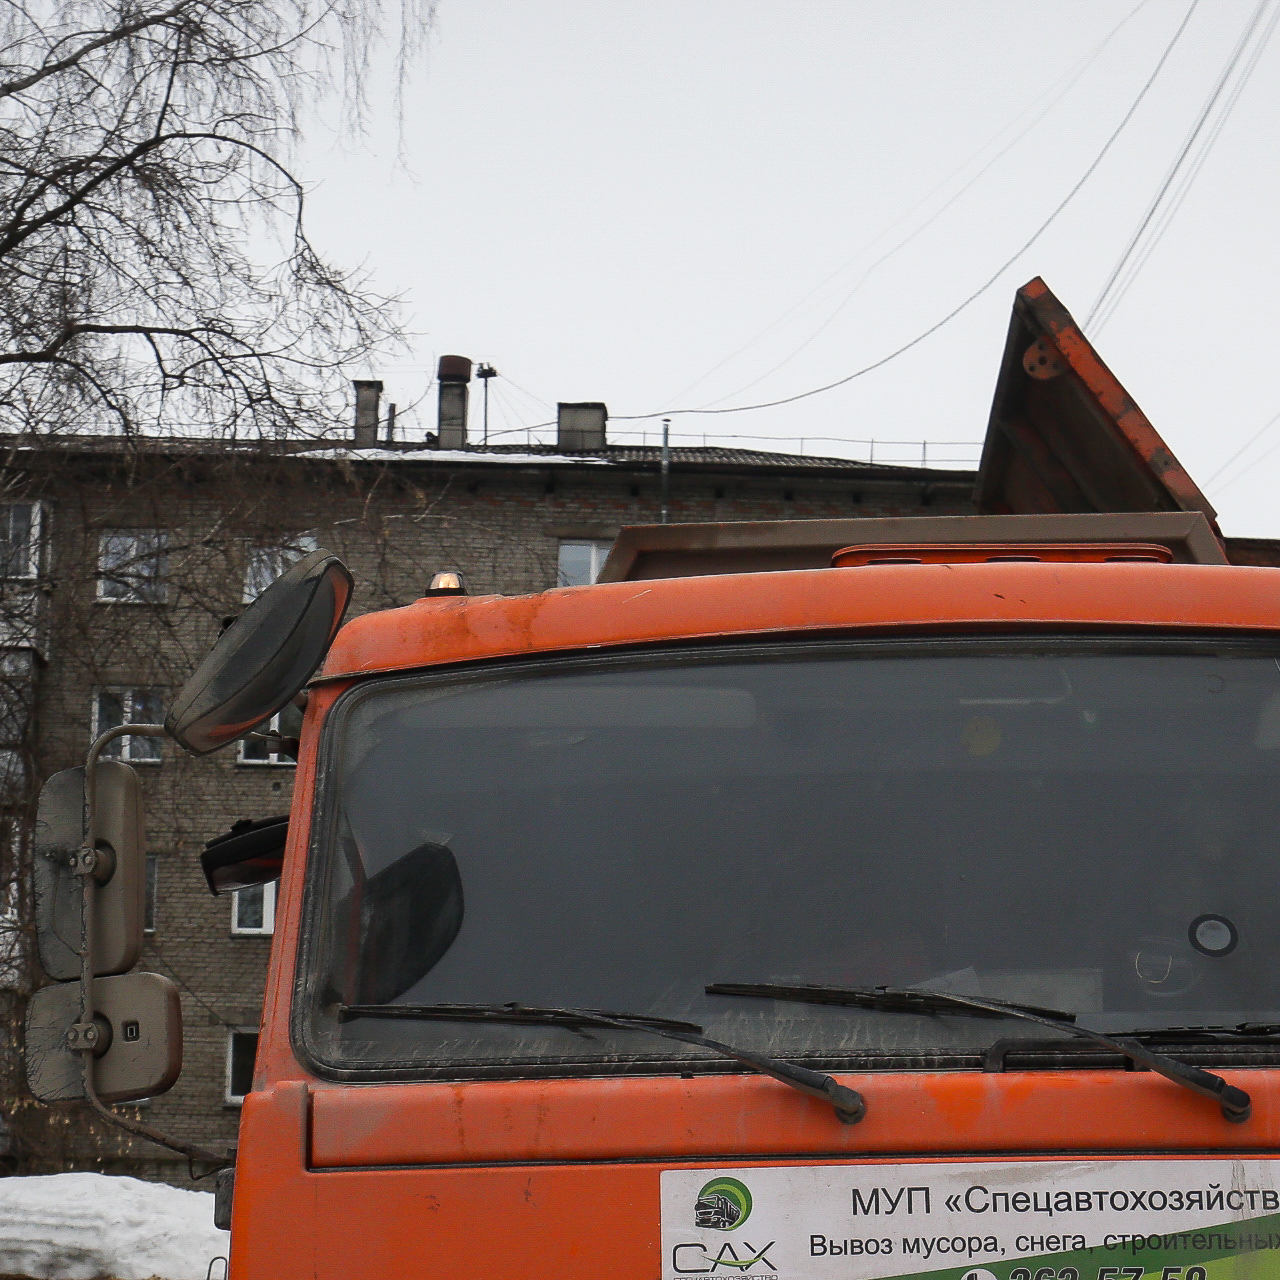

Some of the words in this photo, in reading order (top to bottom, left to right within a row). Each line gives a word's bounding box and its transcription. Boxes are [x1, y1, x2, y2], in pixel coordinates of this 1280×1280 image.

[851, 1186, 931, 1216] МУП
[810, 1234, 893, 1257] Вывоз
[902, 1235, 1006, 1259] мусора,
[1015, 1233, 1094, 1255] снега,
